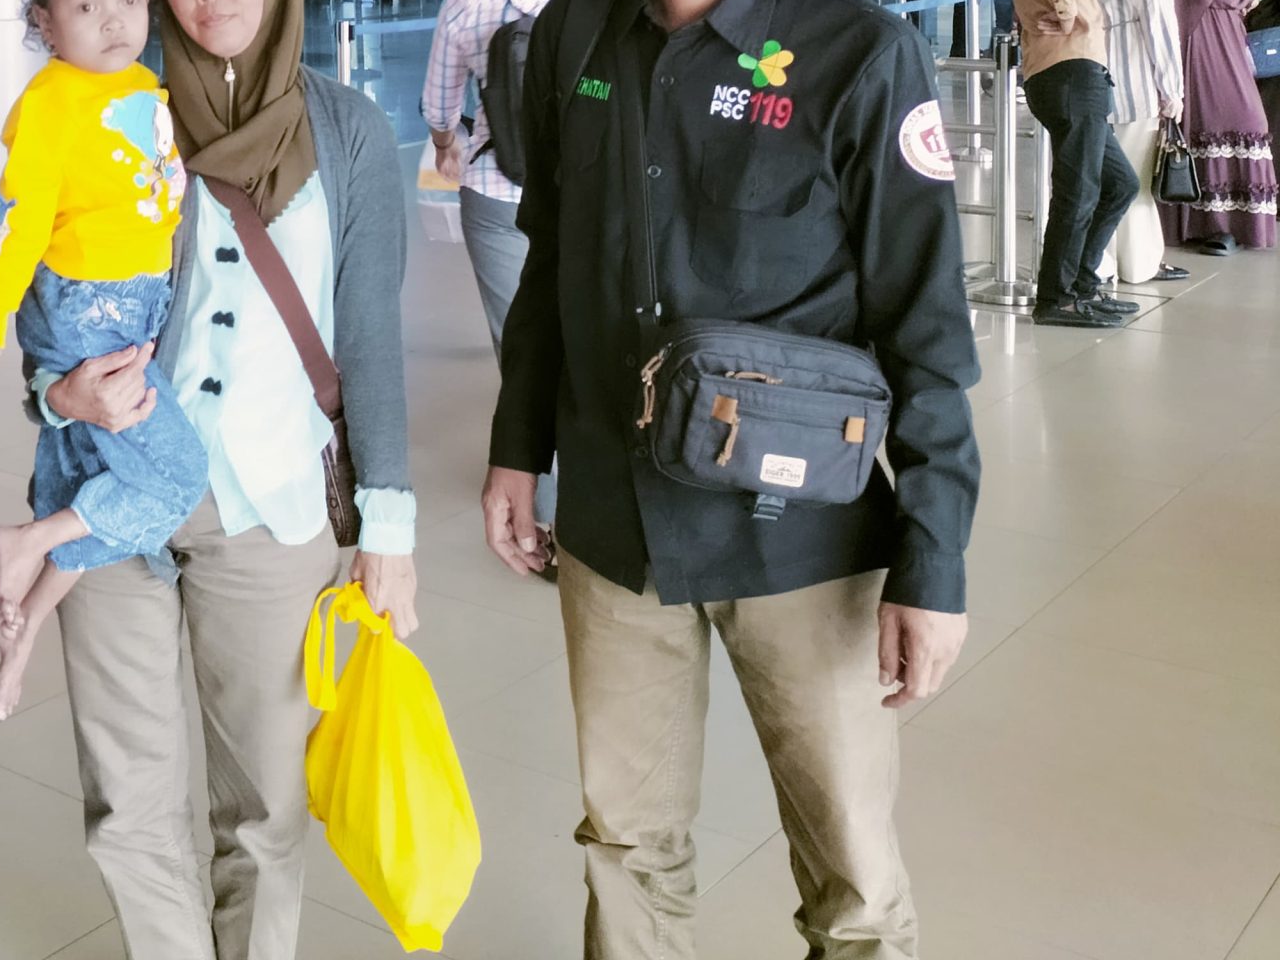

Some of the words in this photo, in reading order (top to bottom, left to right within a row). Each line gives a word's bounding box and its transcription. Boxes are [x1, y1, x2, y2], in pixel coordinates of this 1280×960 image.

[713, 85, 751, 105] NCC
[710, 100, 745, 120] PSC
[749, 92, 794, 130] 119
